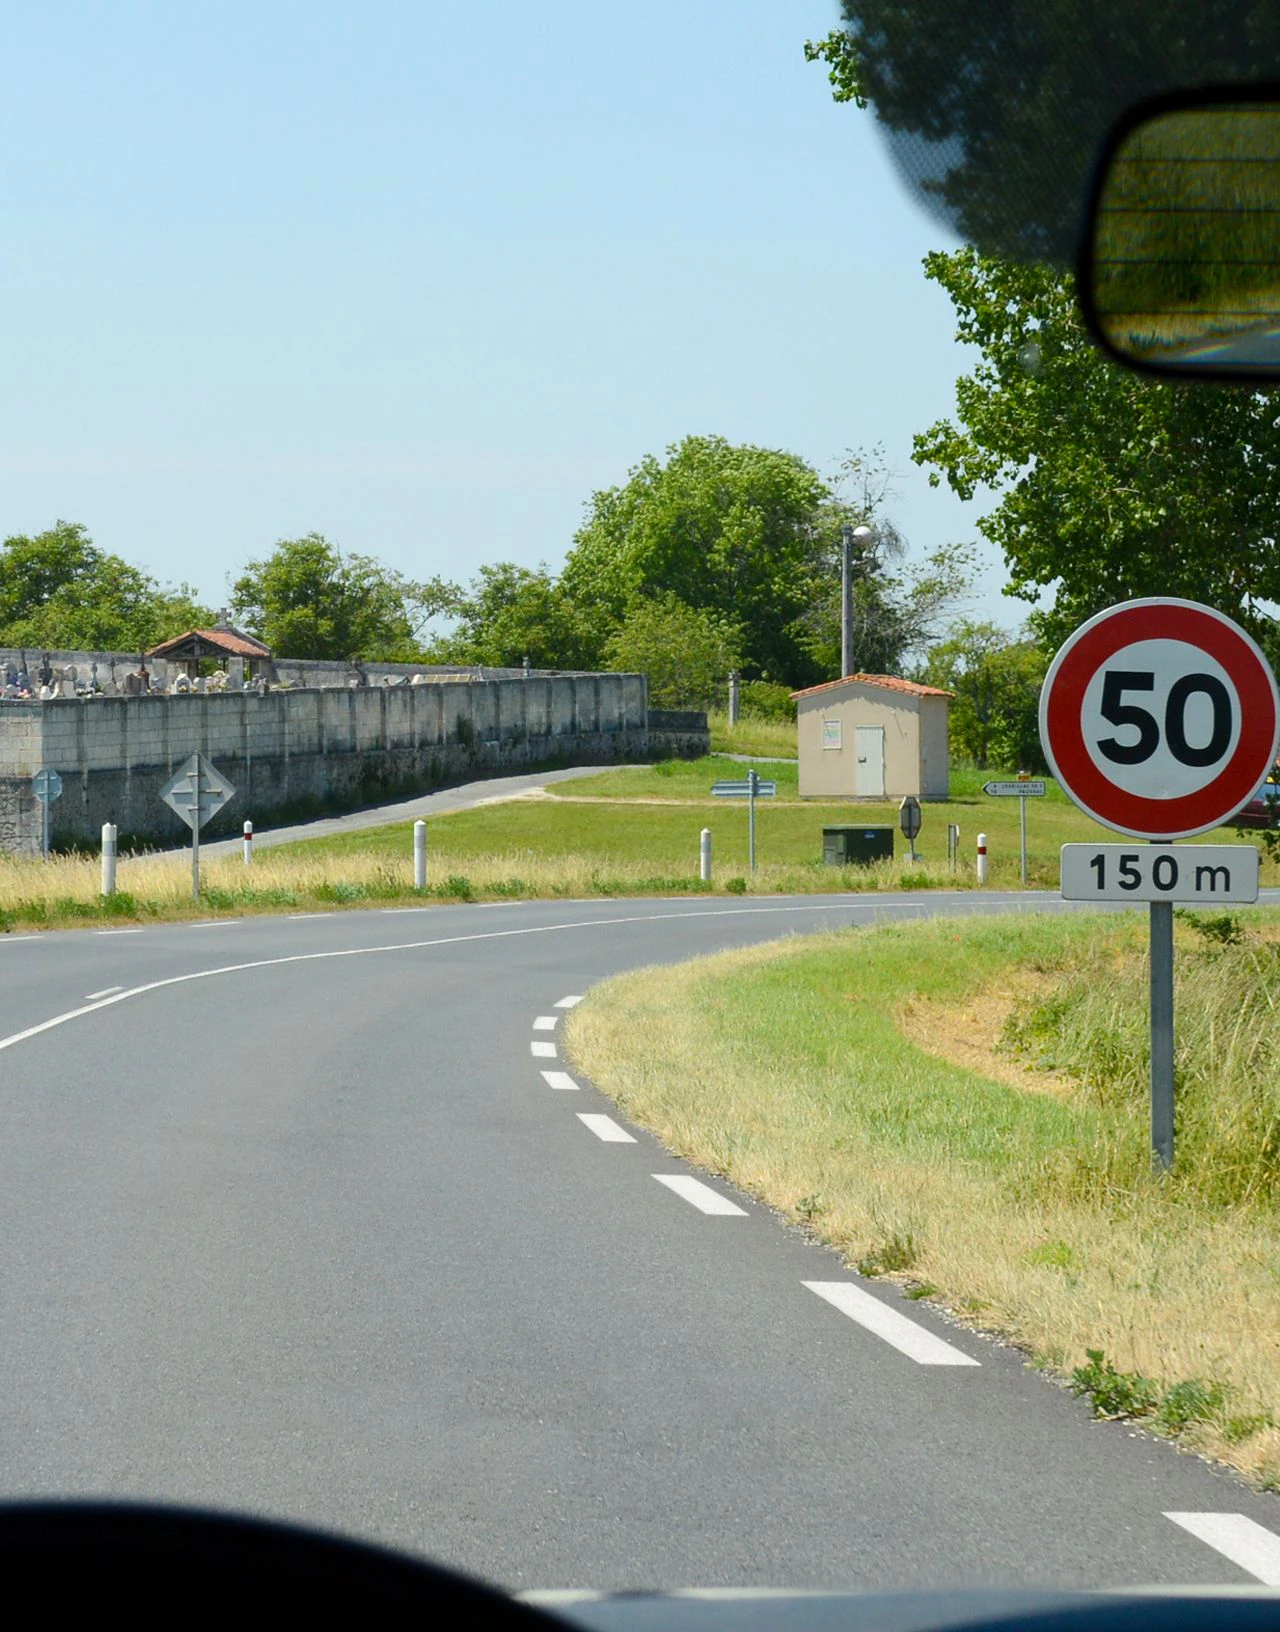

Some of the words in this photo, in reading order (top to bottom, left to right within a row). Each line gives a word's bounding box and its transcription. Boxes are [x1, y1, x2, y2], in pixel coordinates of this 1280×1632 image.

[1096, 670, 1233, 768] 50
[1090, 854, 1178, 891] 150
[1195, 866, 1231, 892] m
